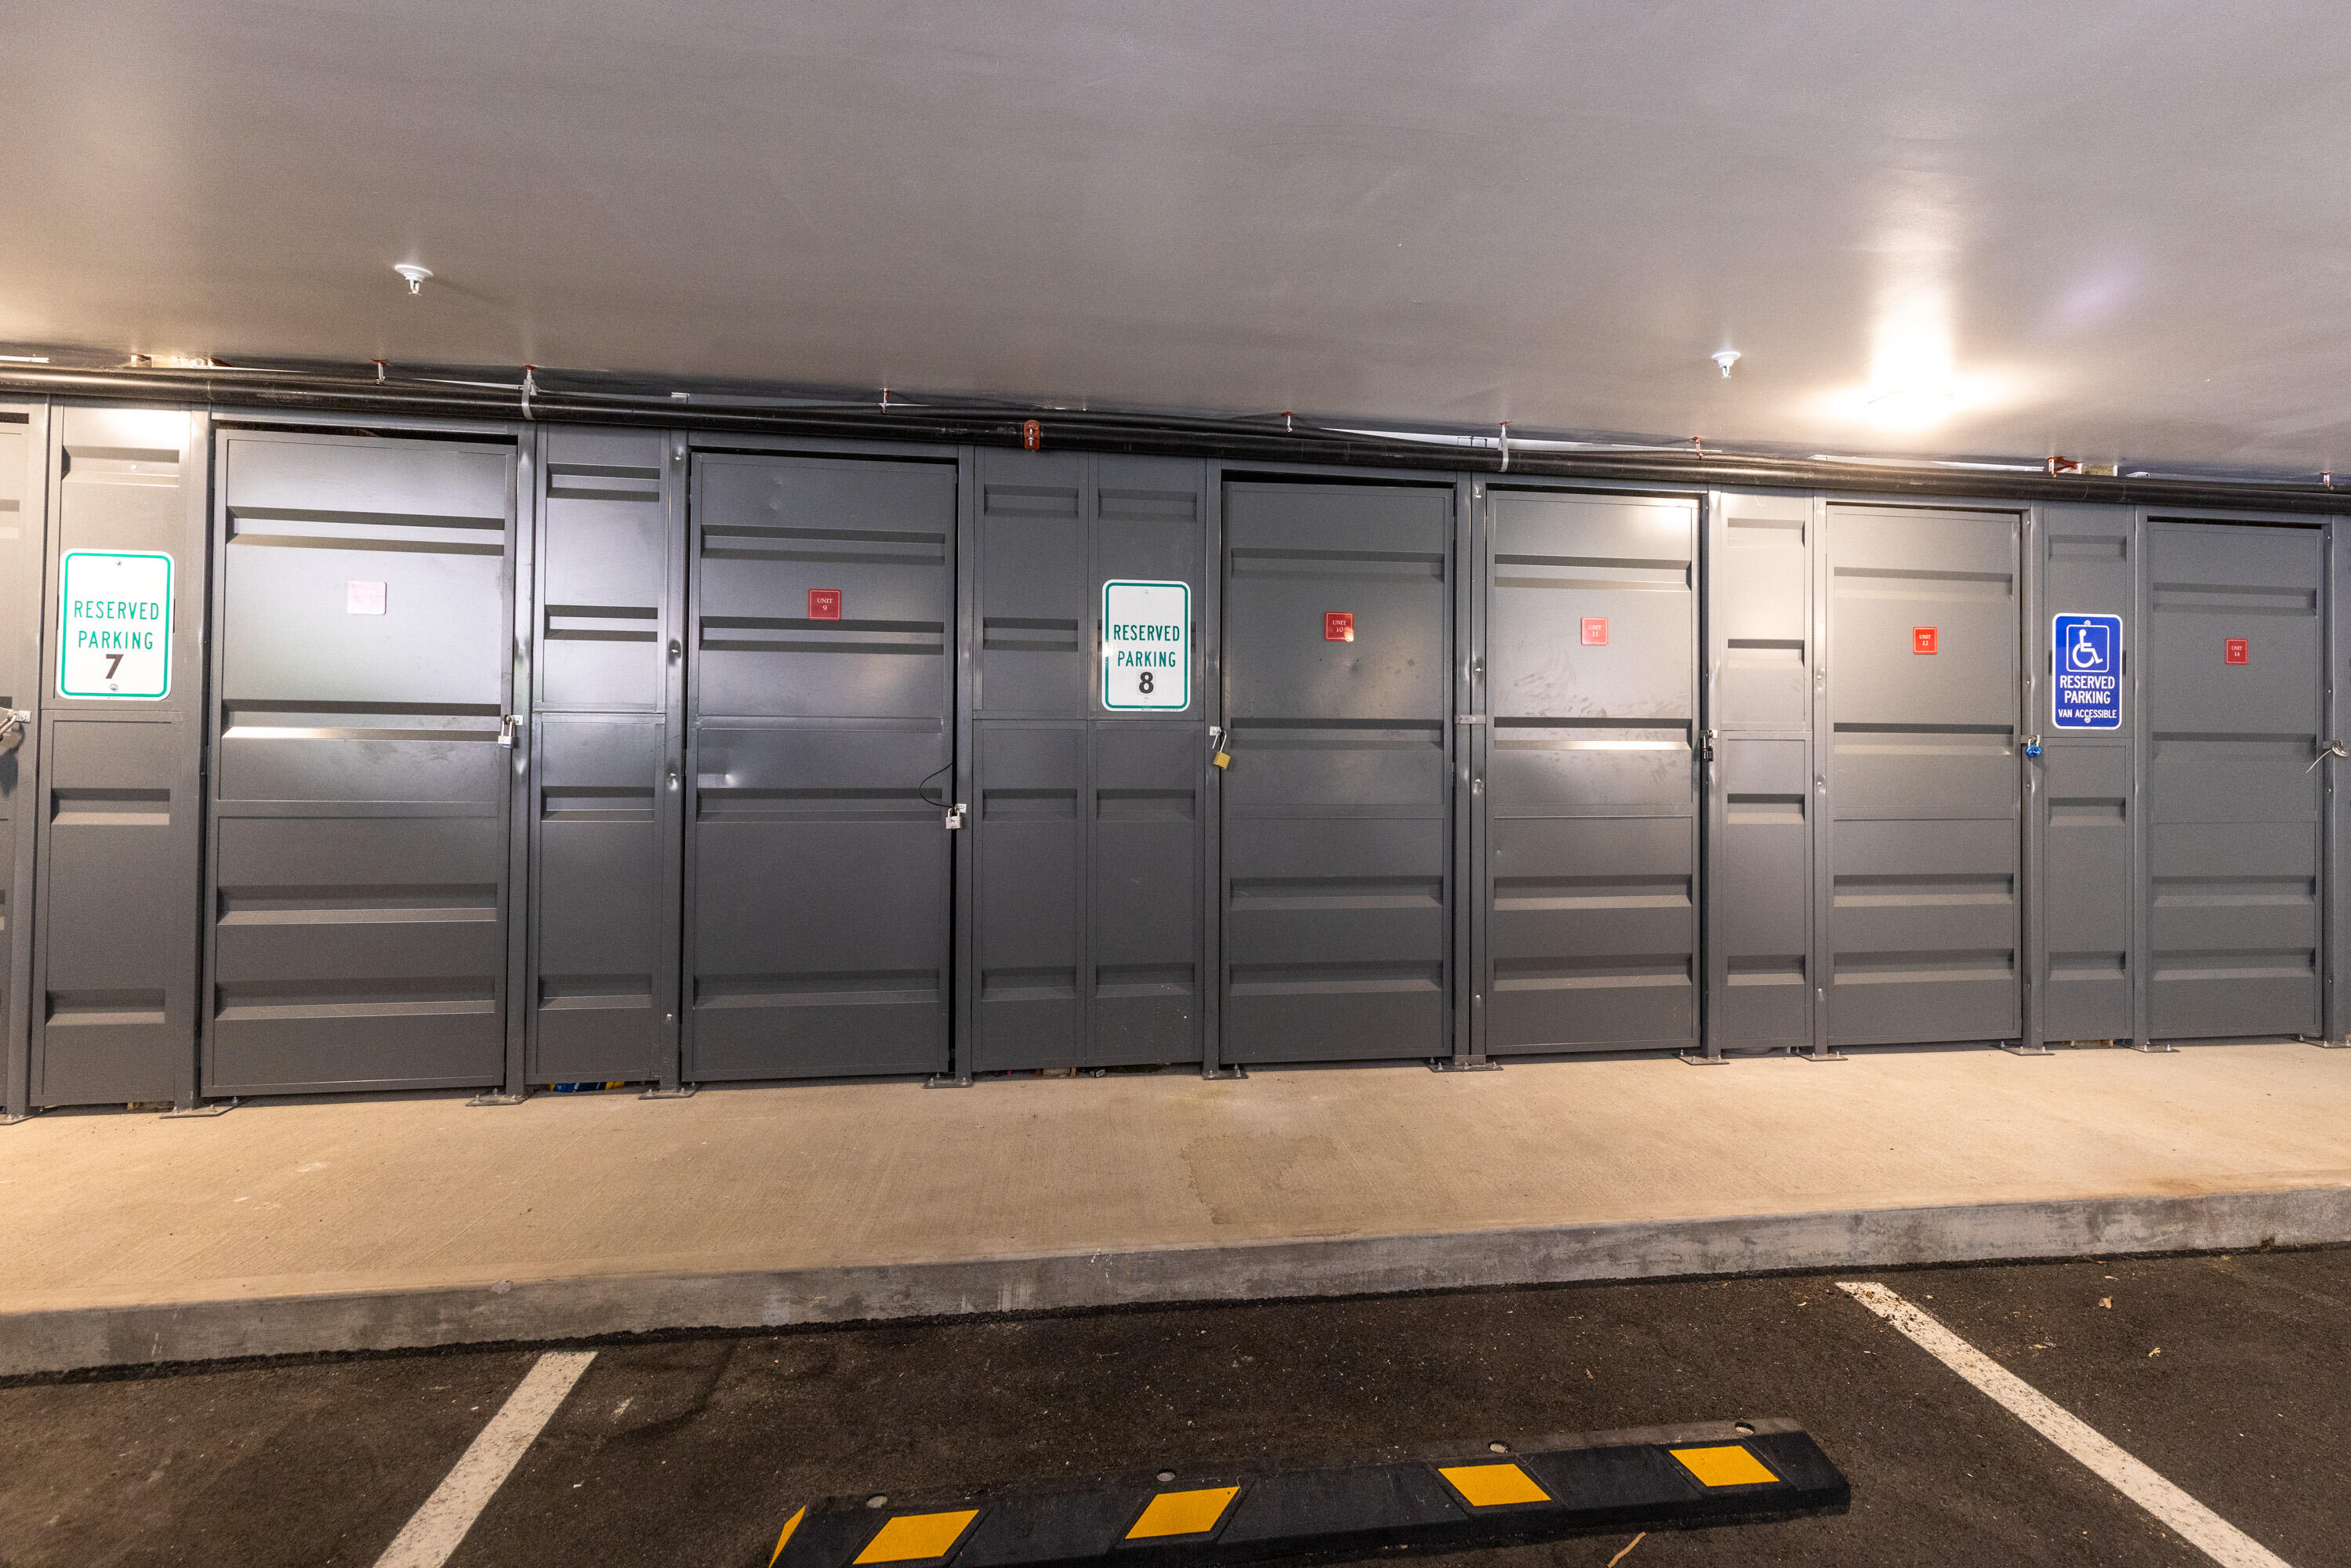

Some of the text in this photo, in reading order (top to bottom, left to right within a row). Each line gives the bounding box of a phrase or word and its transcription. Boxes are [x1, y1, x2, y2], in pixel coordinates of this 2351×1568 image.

[74, 601, 159, 619] RESERVED
[78, 630, 153, 649] PARKING
[1114, 625, 1180, 641] RESERVED
[105, 654, 124, 679] 7
[1118, 651, 1176, 667] PARKING
[1138, 671, 1154, 694] 8
[2060, 675, 2115, 689] RESERVED
[2064, 691, 2110, 704] PARKING
[2058, 709, 2117, 718] VAN ACCESSIBLE
